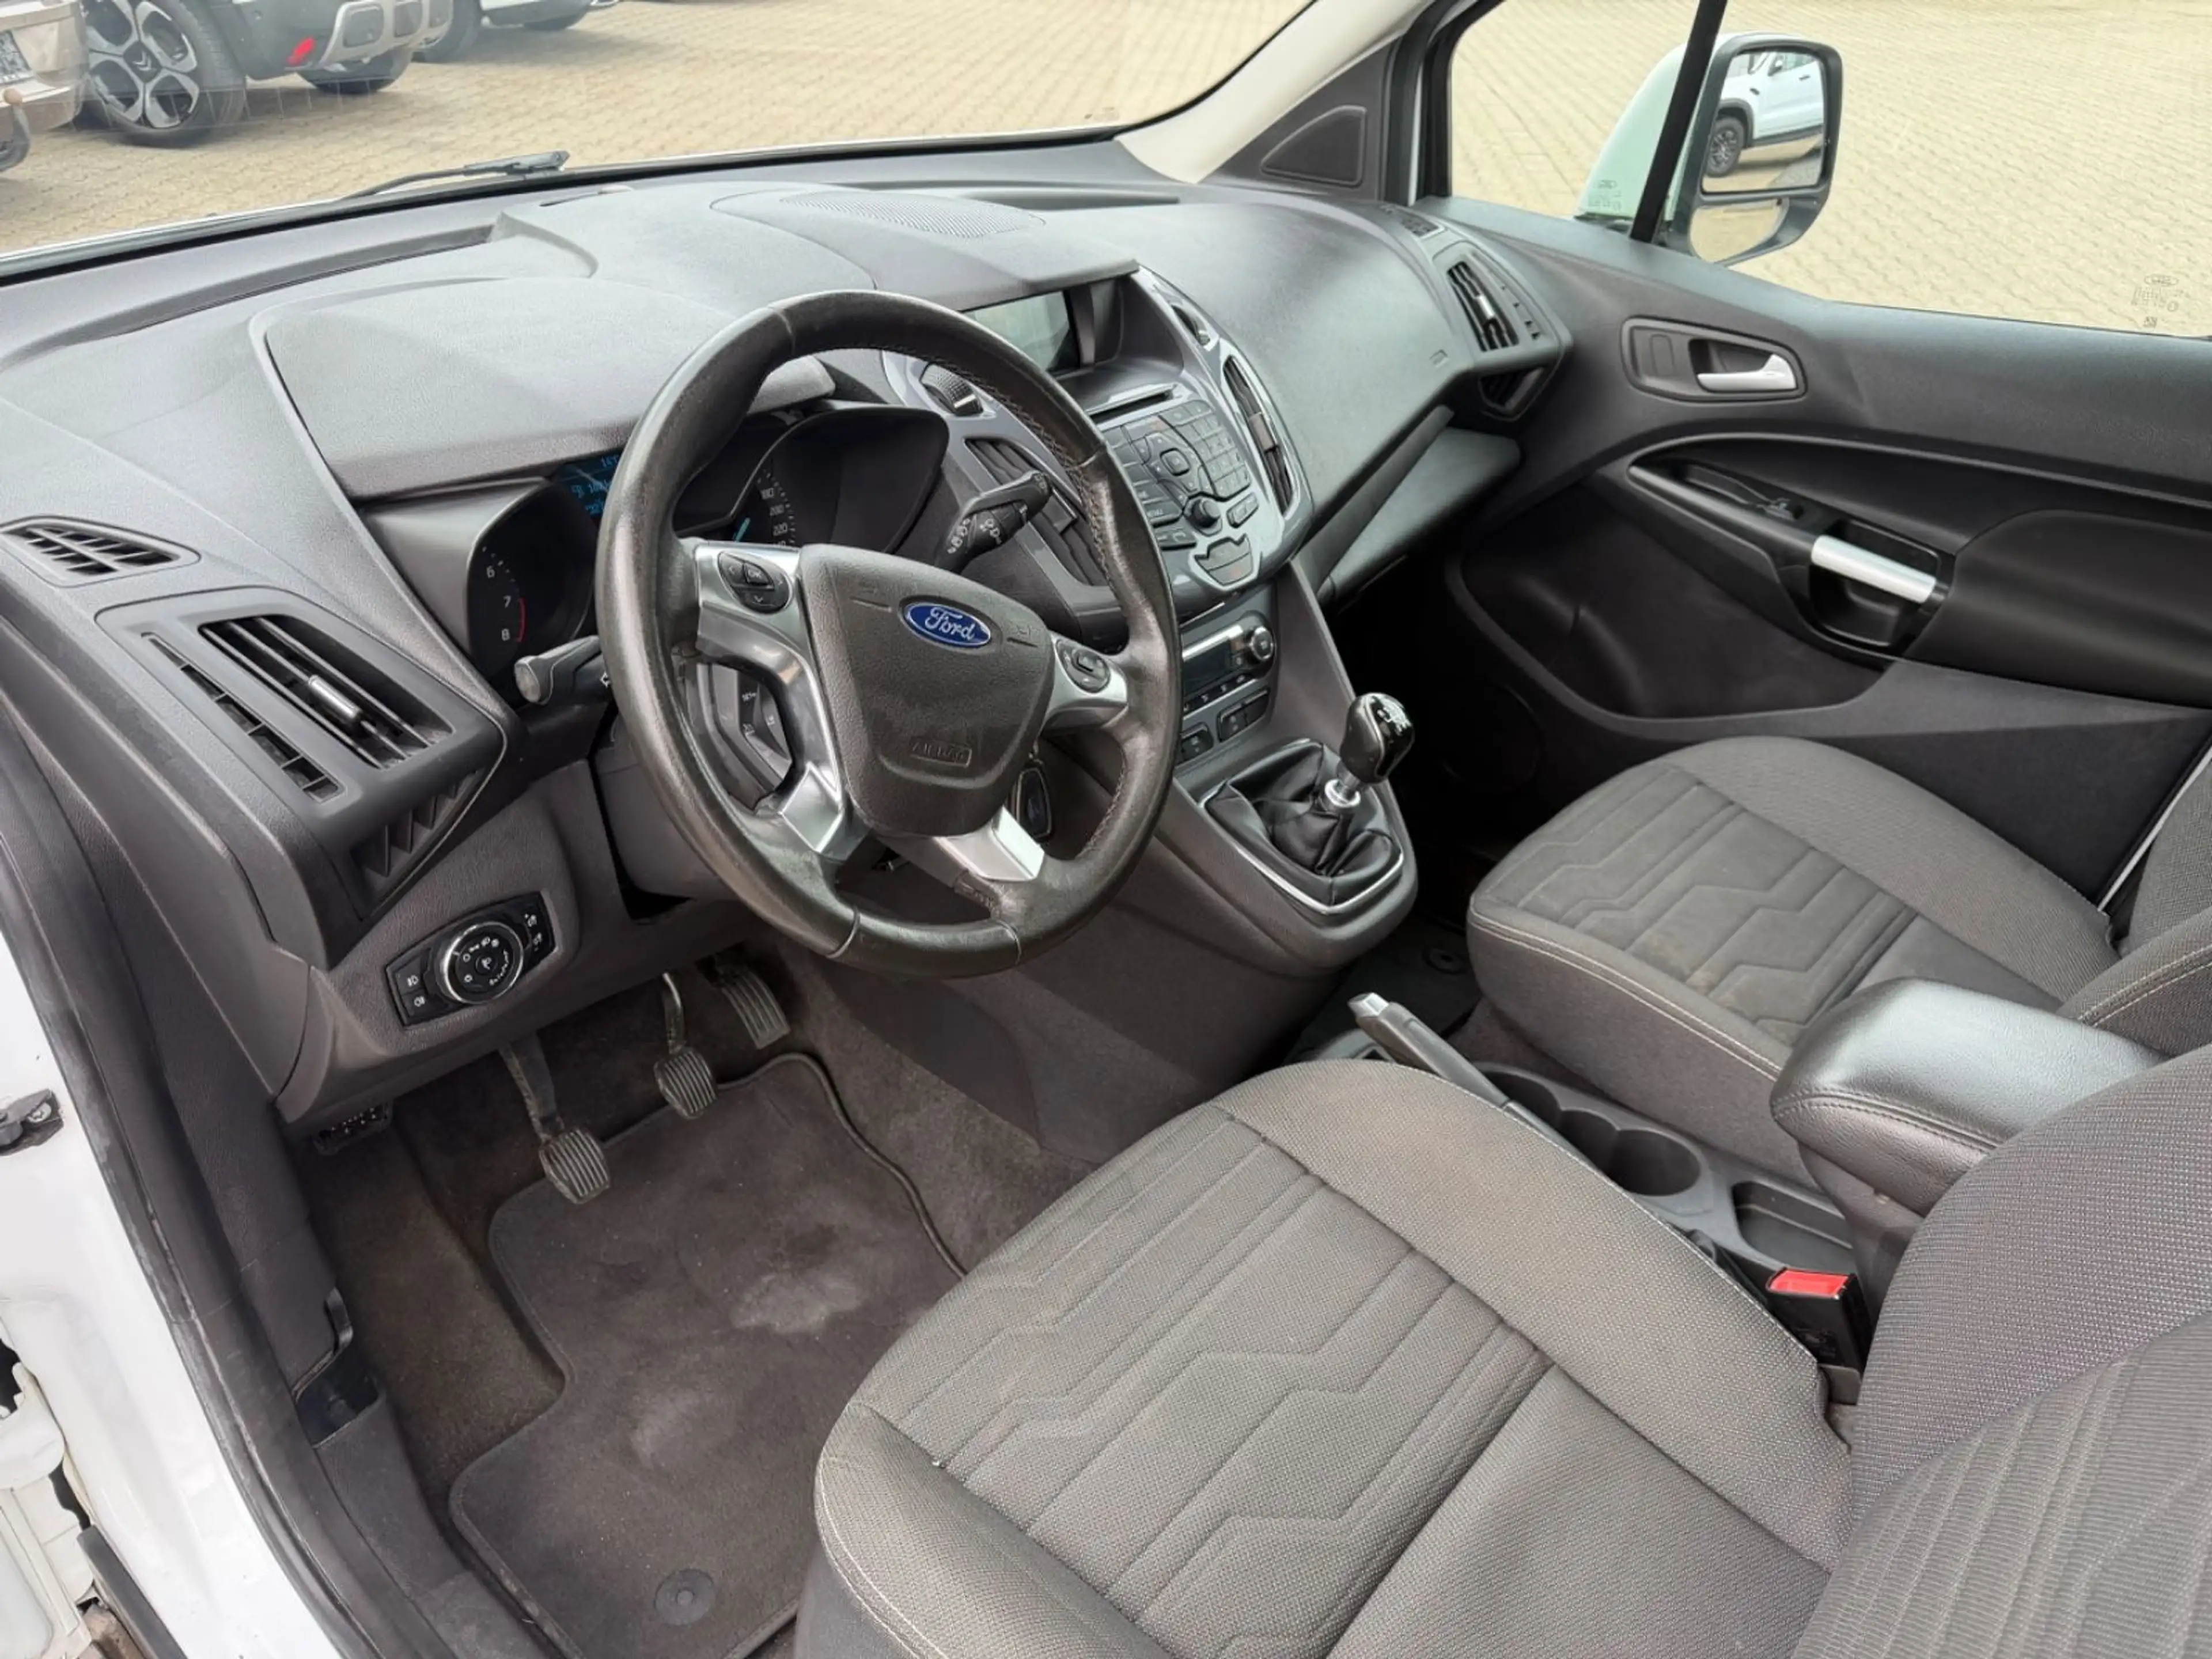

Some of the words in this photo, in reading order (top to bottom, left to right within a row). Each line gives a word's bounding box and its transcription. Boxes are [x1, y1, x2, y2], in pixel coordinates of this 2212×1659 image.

[486, 565, 495, 578] 6
[503, 595, 512, 608] 7
[925, 607, 976, 641] Ford
[501, 628, 510, 641] 8
